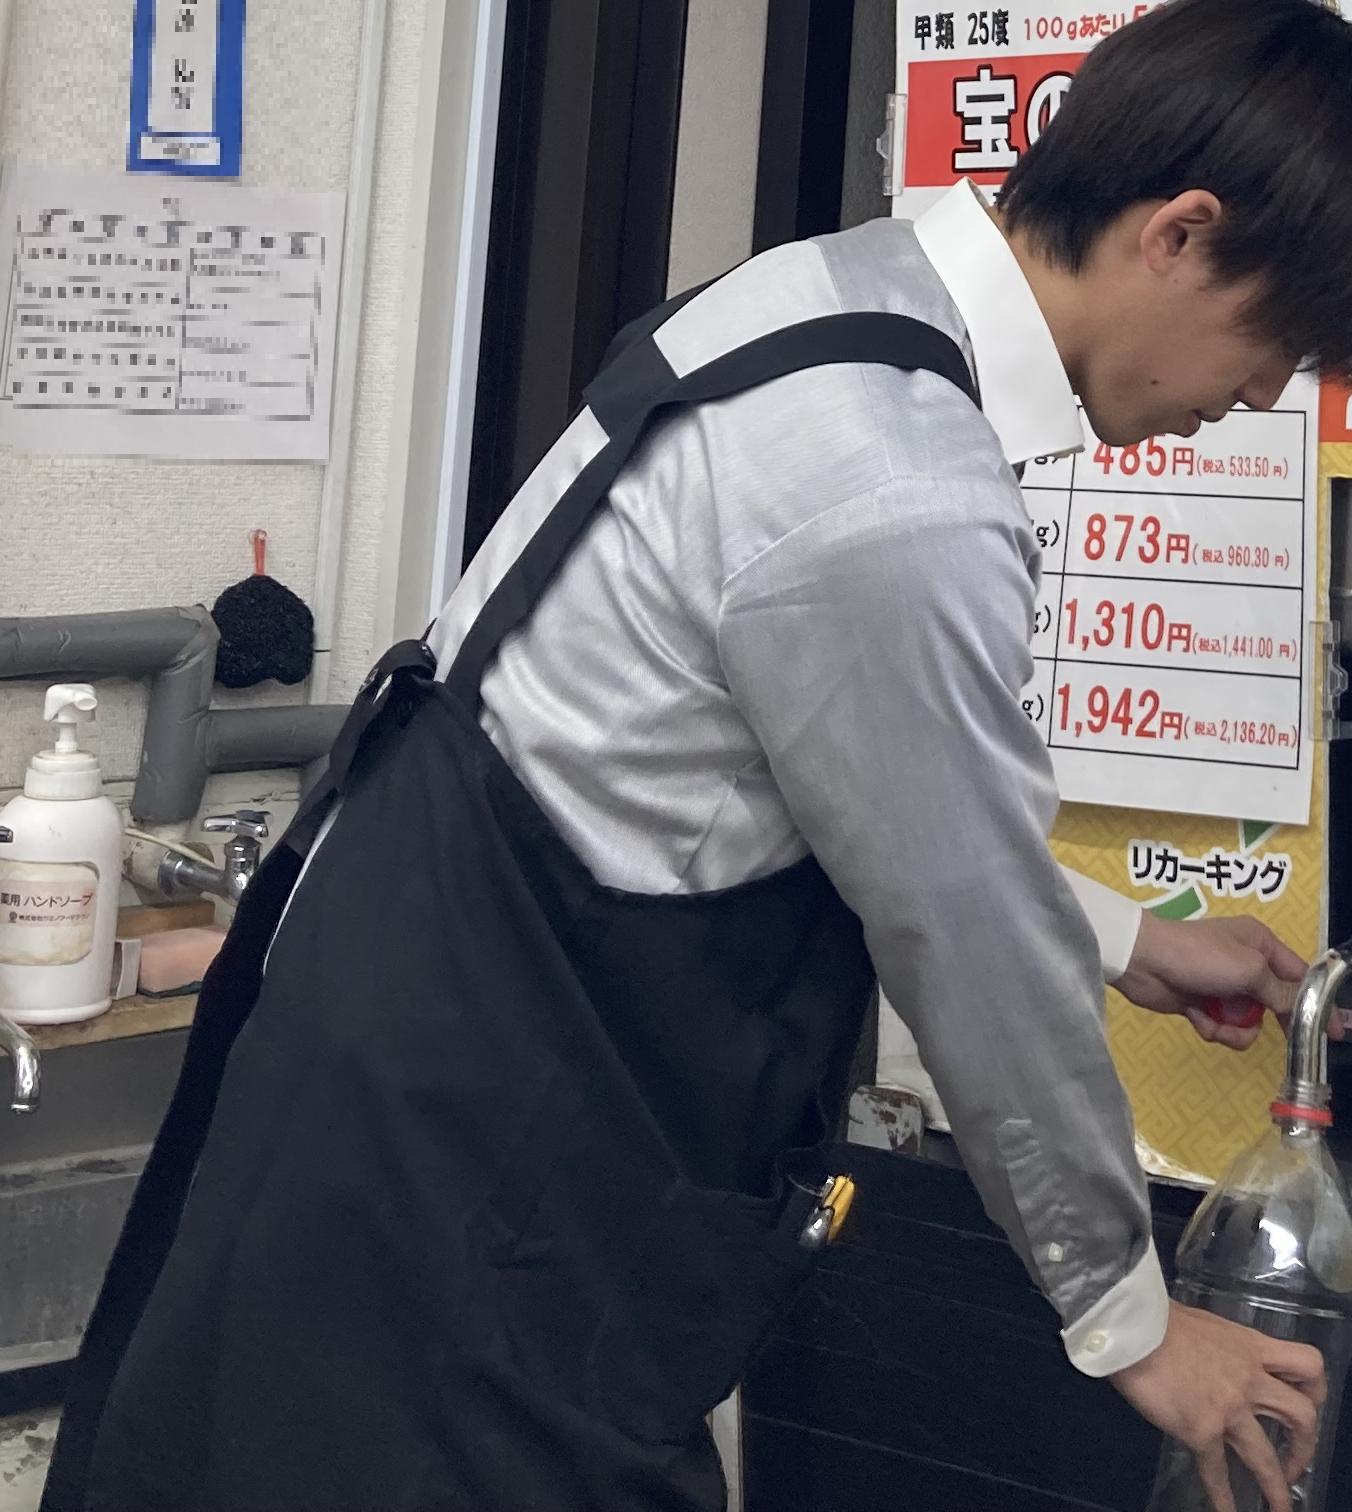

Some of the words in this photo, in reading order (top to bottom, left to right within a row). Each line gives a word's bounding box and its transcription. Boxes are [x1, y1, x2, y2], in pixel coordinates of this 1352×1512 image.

[914, 11, 955, 51] 甲類
[968, 8, 1010, 47] 25度
[1131, 844, 1288, 895] リカーキング
